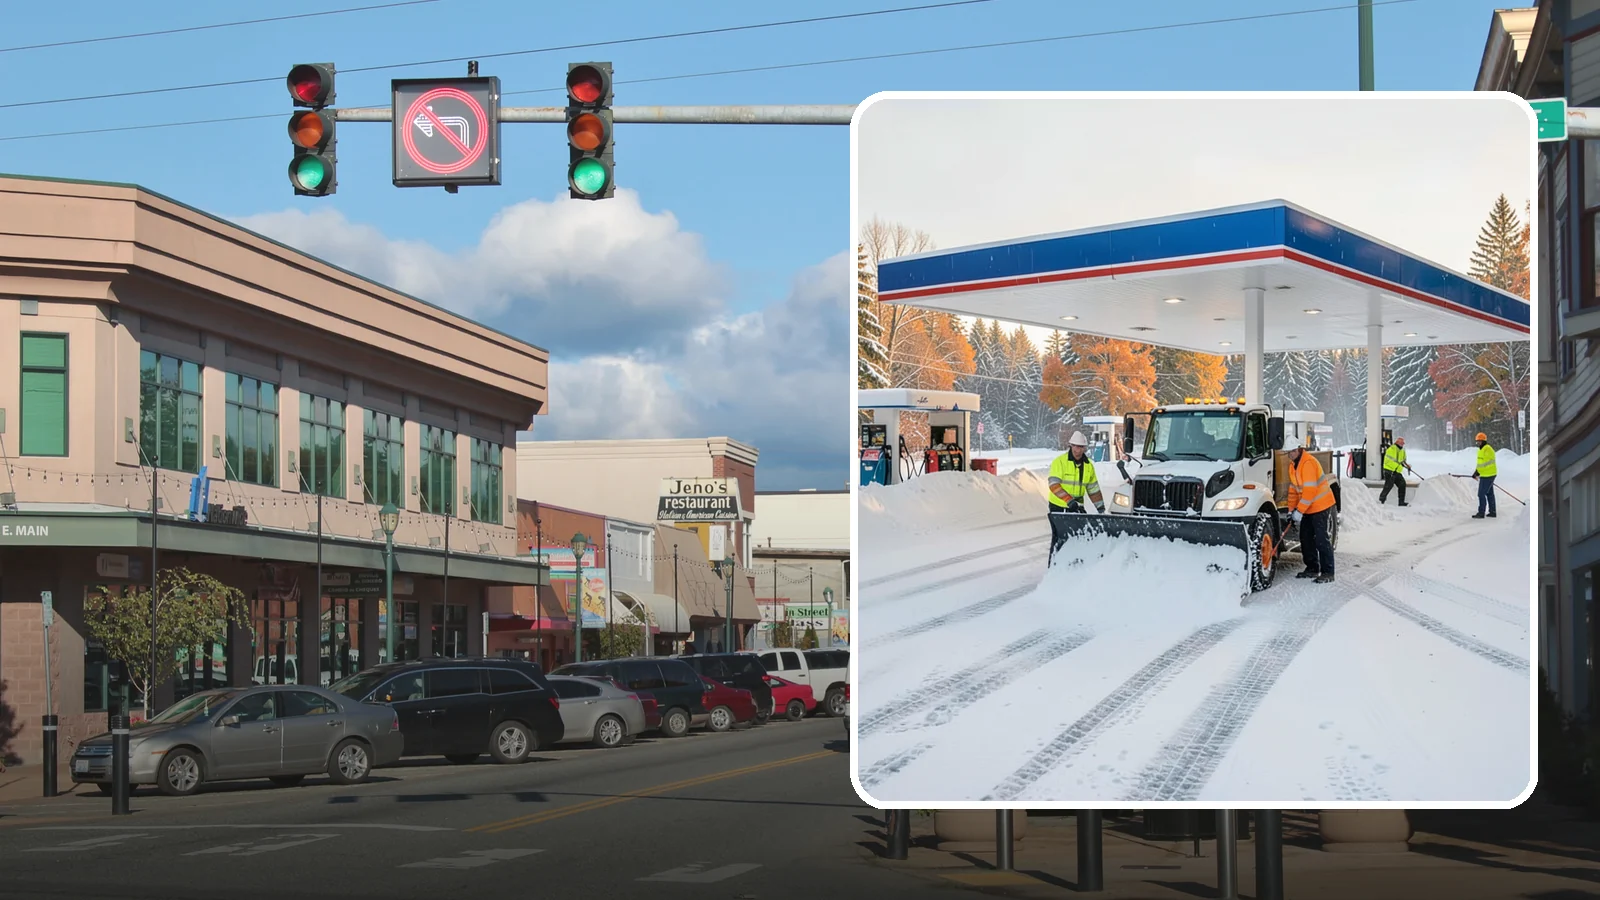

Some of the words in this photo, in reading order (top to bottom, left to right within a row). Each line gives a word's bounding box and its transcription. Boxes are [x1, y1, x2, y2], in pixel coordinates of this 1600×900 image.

[669, 480, 727, 495] Jeno's
[665, 496, 731, 509] restaurant
[658, 509, 681, 519] Italian
[686, 509, 714, 519] American
[715, 509, 737, 519] Cuisine
[2, 525, 13, 536] E.
[15, 525, 49, 536] MAIN
[797, 607, 828, 617] Street
[791, 619, 823, 627] lass
